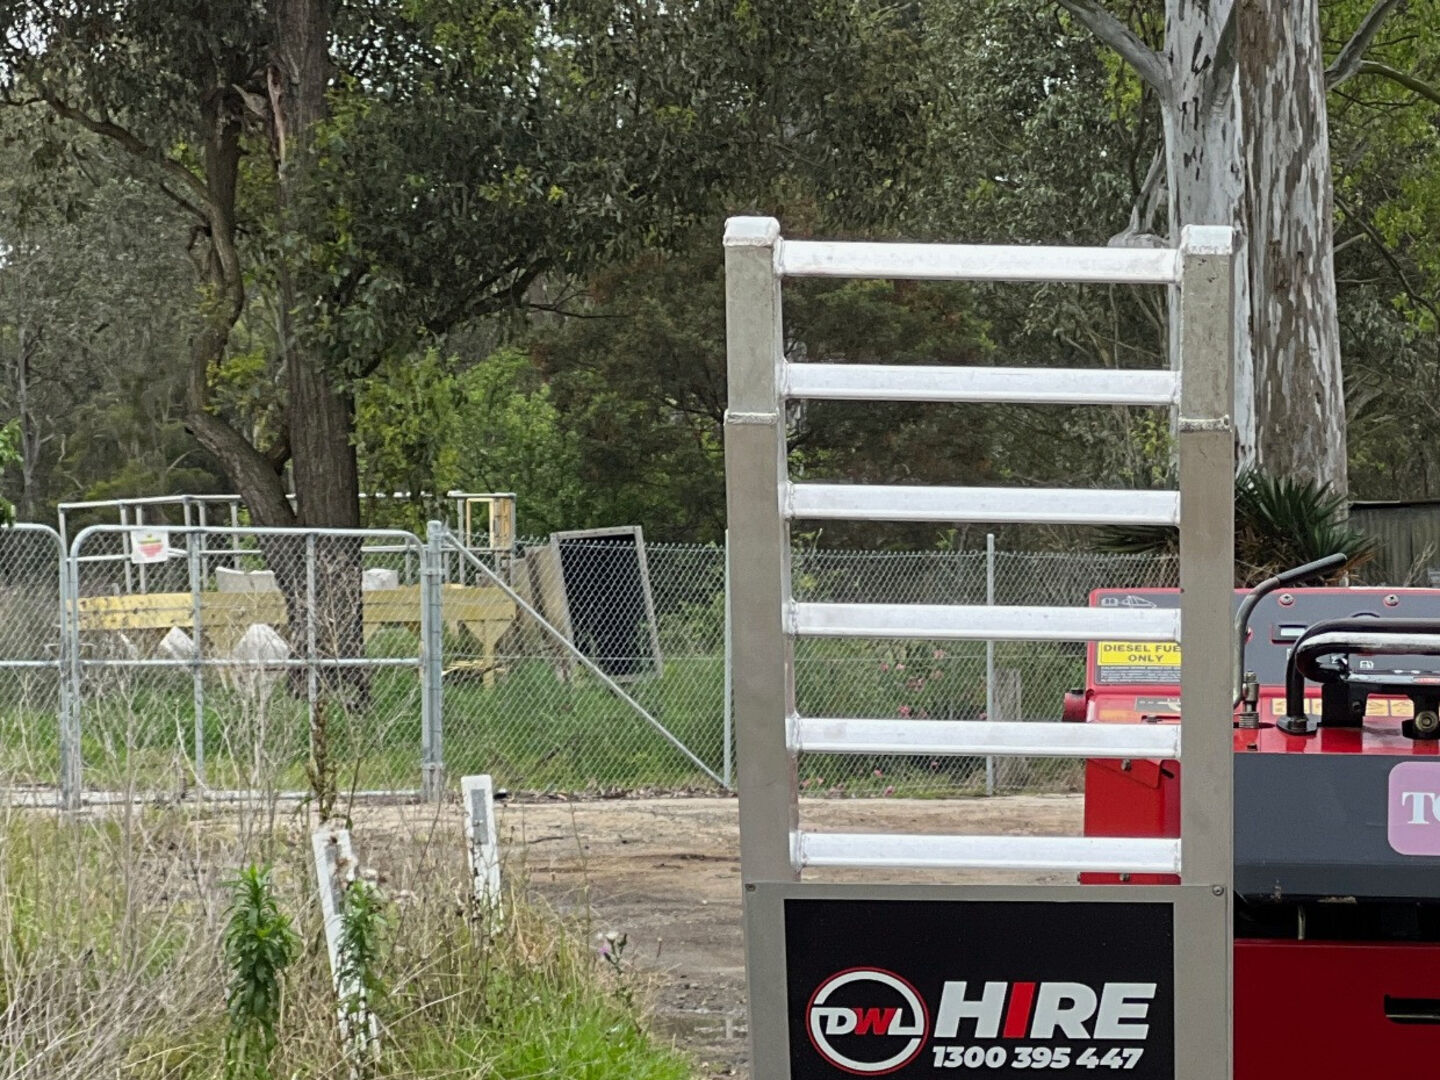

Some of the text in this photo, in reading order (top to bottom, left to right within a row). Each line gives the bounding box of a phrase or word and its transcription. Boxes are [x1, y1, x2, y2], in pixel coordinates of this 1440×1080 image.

[1103, 644, 1181, 653] DIESEL FUE
[1127, 654, 1164, 662] ONLY
[933, 981, 1158, 1040] HIRE
[931, 1045, 1144, 1070] 1300 395 447
